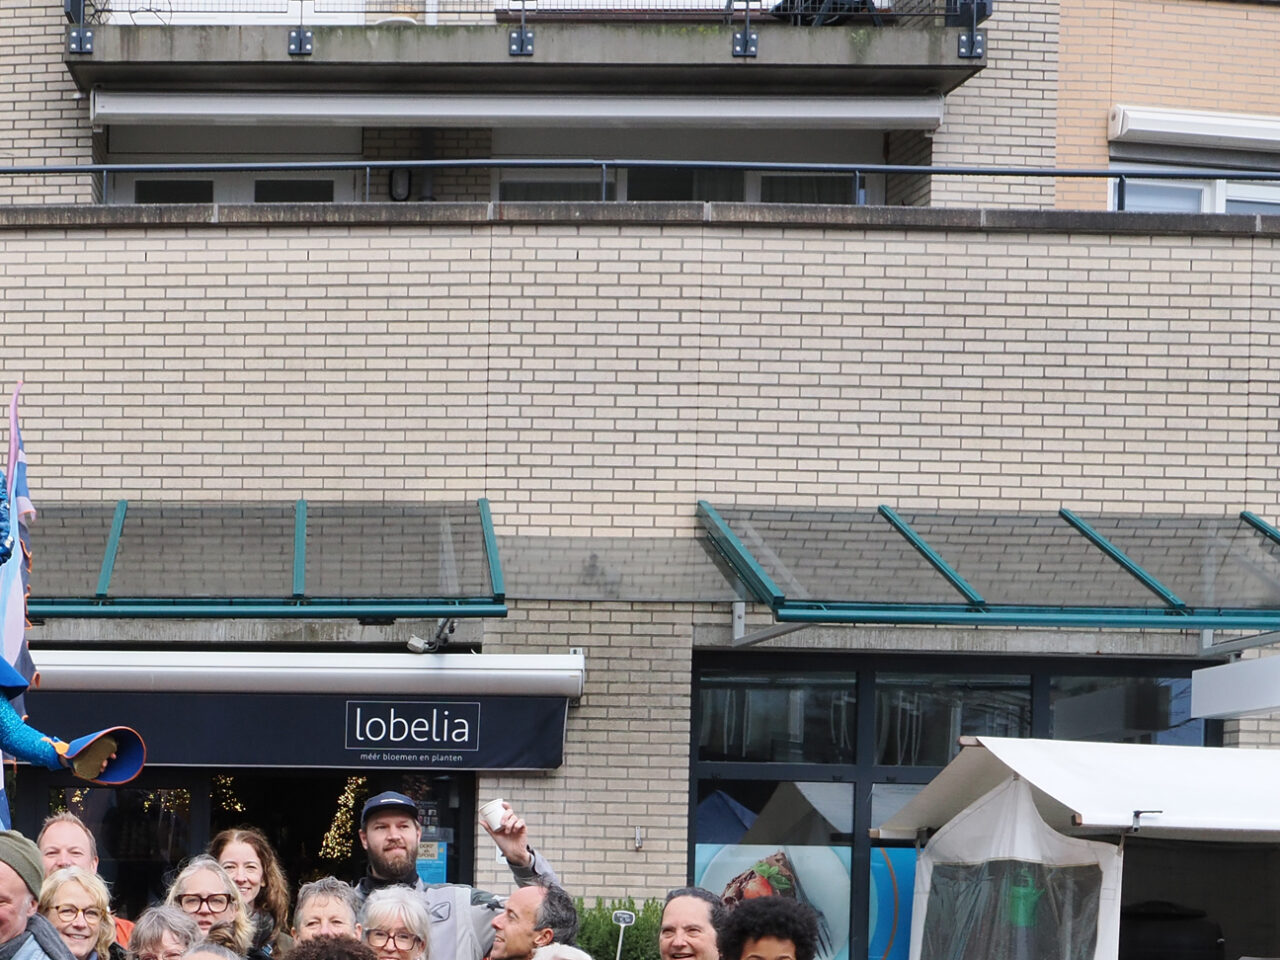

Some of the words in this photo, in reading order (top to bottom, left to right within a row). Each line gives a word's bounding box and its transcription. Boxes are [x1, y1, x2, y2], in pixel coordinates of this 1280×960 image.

[355, 707, 469, 742] lobelia
[360, 752, 380, 760] méér
[382, 752, 417, 761] bloemen
[431, 753, 463, 763] planten
